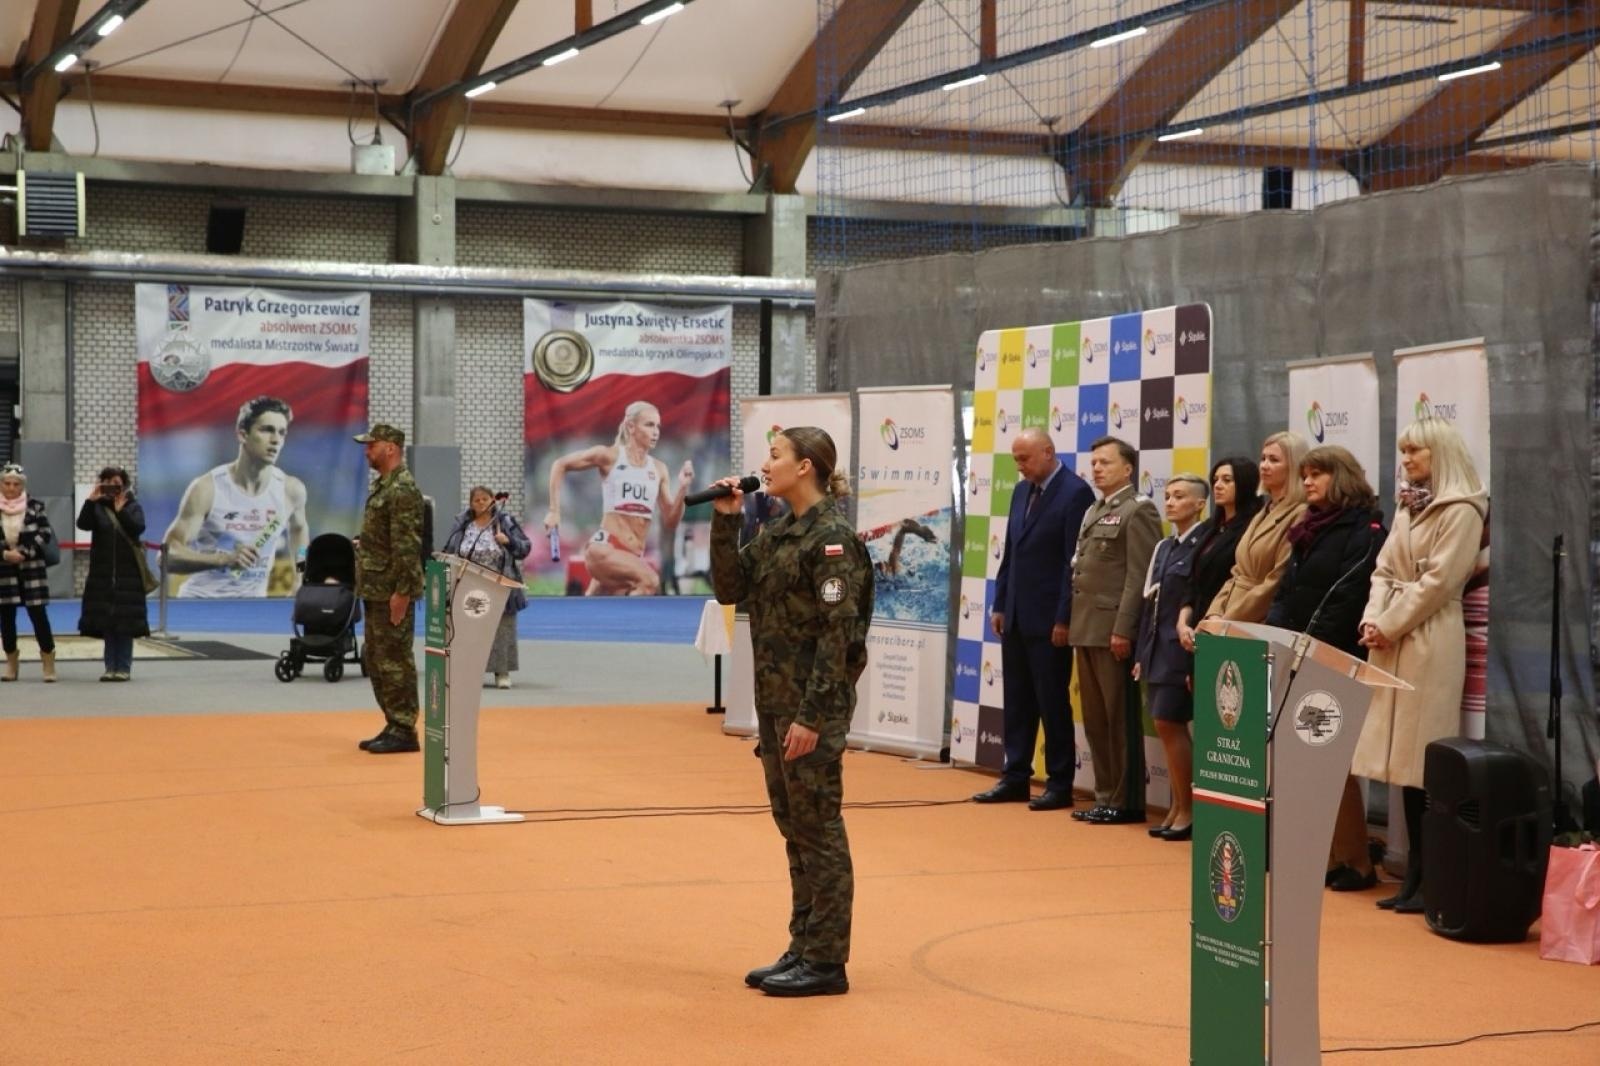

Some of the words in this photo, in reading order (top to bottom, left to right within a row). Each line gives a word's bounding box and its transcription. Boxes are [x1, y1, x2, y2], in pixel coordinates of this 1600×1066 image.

[204, 297, 254, 316] Patryk
[257, 299, 360, 318] Grzegorzewicz
[260, 321, 317, 335] absolwent
[320, 322, 358, 336] ZSOMS
[585, 312, 634, 329] Justyna
[636, 312, 725, 331] Święty-Ersetic
[210, 338, 263, 351] medalista
[265, 339, 322, 353] Mistrzostw
[325, 338, 360, 354] Świata
[639, 333, 694, 346] absolwentka
[695, 334, 725, 346] ZSOMS
[599, 347, 644, 359] medalistka
[1325, 411, 1349, 428] ZSOMS
[900, 427, 926, 440] ZSOMS
[860, 466, 940, 486] Swimming
[622, 482, 649, 501] POL
[1217, 736, 1241, 751] STRAŻ
[1207, 750, 1252, 769] GRANICZNA
